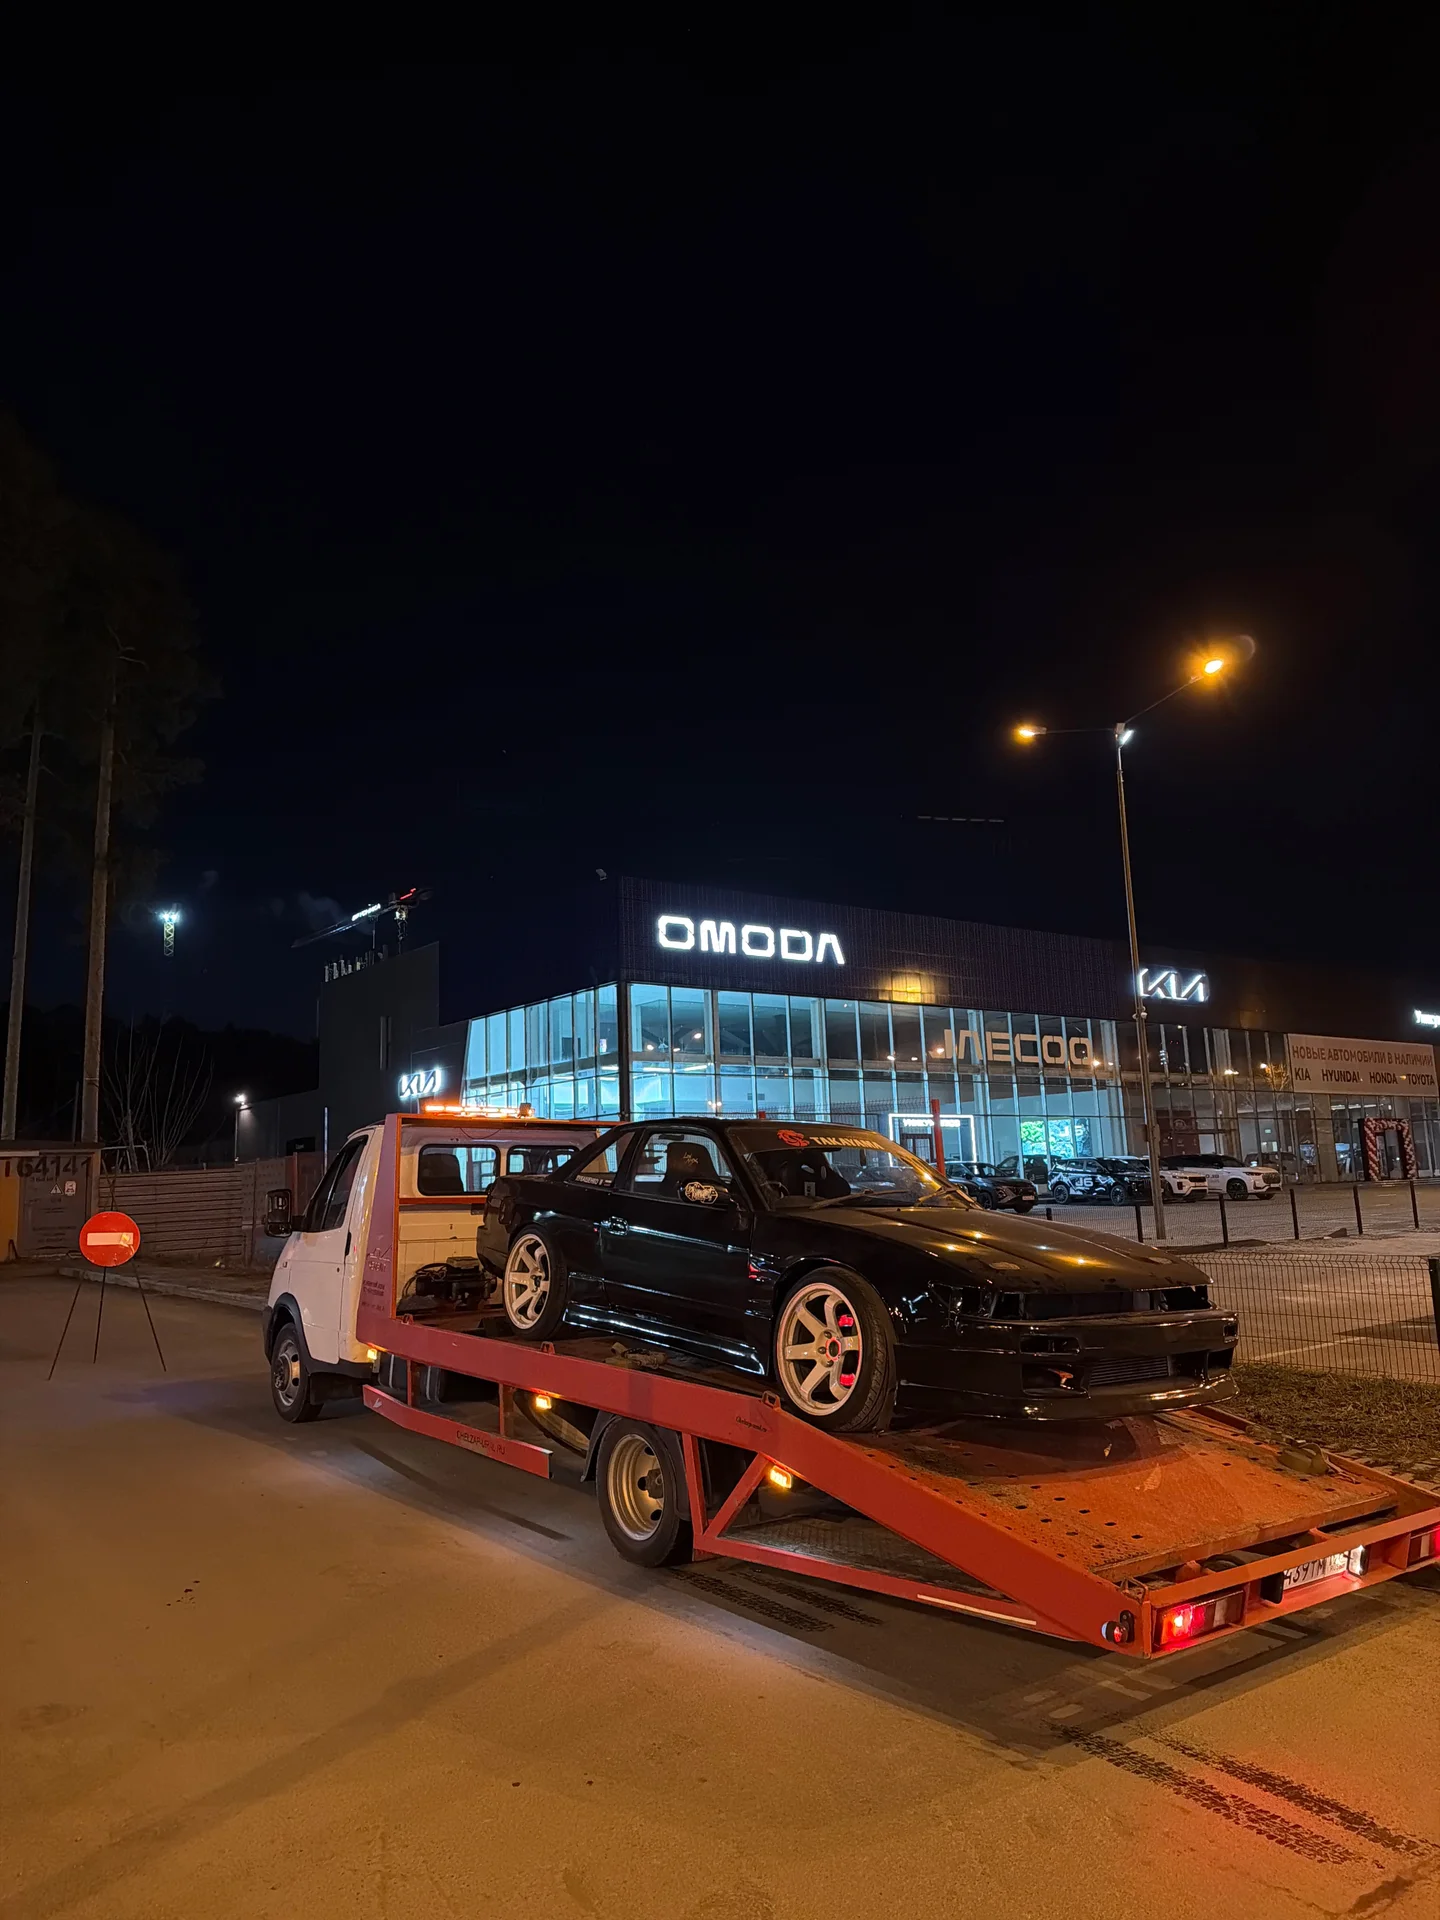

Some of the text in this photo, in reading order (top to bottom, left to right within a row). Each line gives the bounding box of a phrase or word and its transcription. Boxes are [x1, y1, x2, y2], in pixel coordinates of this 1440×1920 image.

[658, 915, 845, 965] OMODA
[1139, 966, 1209, 1003] KIA
[929, 1029, 1091, 1066] JAECOO
[1292, 1045, 1434, 1067] НОВЫЕ АВТОМОБИЛИ В НАЛИЧИИ
[398, 1067, 442, 1098] KIA
[1294, 1068, 1436, 1086] KIA HYUNDAI HONDA TOYOTA
[809, 1136, 885, 1150] TAKAYAMA
[1075, 1177, 1094, 1187] J6
